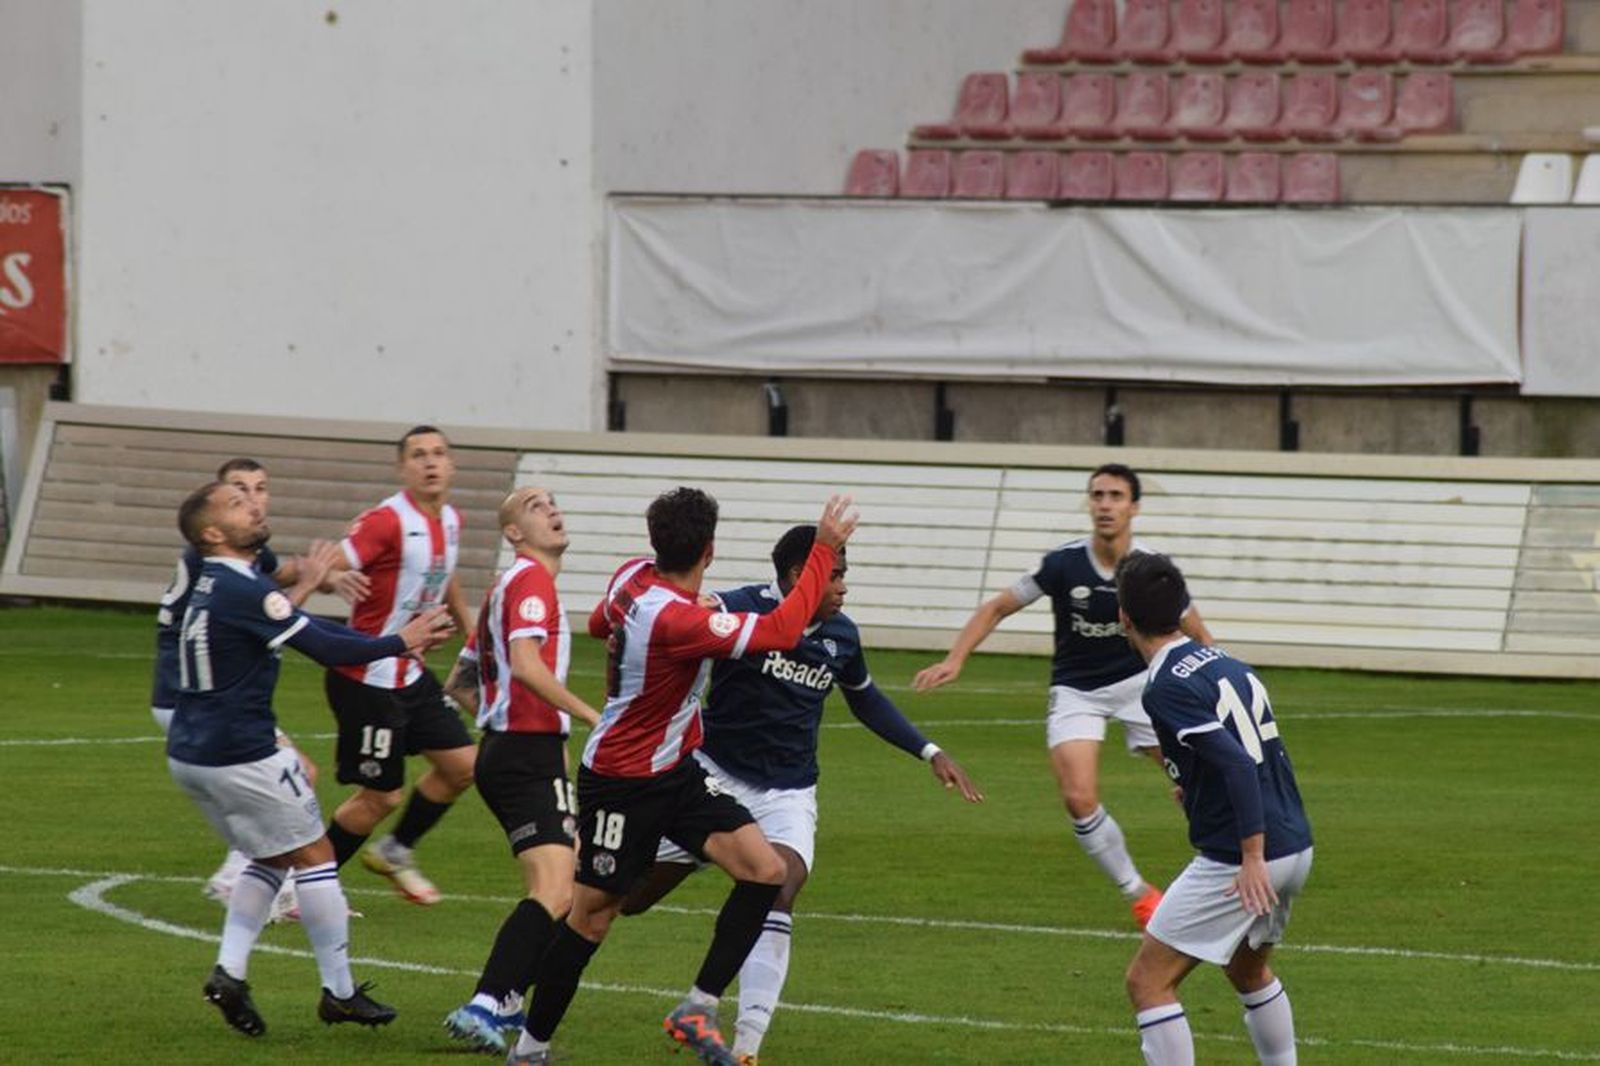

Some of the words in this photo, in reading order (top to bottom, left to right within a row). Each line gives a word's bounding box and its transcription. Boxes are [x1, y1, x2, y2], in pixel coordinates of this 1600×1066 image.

[760, 650, 834, 691] Posada
[1216, 671, 1280, 765] 14
[359, 723, 394, 759] 19
[592, 808, 627, 850] 18
